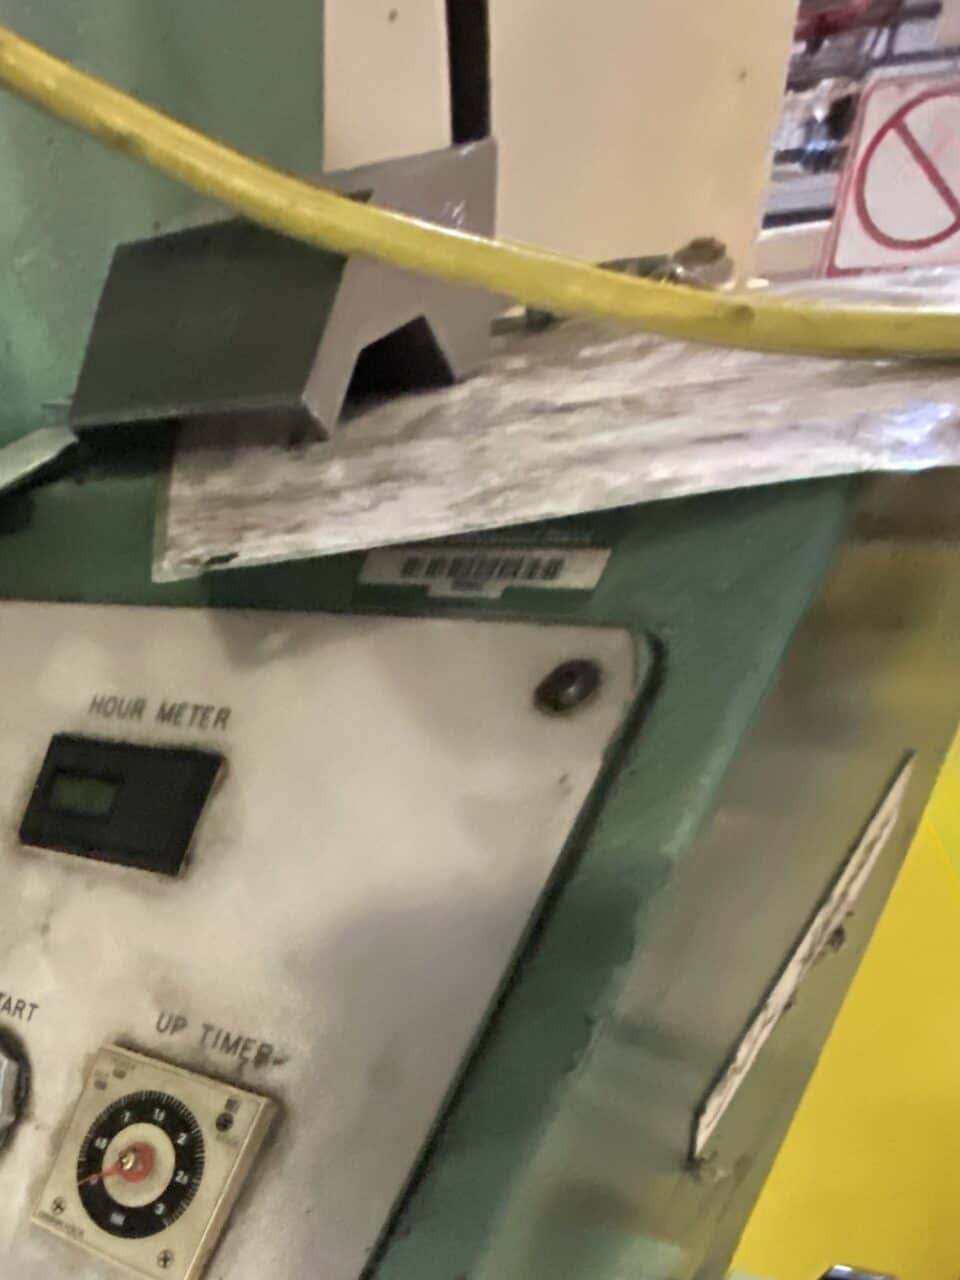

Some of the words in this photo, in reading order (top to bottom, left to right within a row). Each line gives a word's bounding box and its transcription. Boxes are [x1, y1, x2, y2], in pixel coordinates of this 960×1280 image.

[88, 694, 147, 721] HOUR
[154, 699, 232, 732] METER
[155, 1010, 188, 1036] UP
[200, 1022, 274, 1070] TIMER
[176, 1132, 188, 1145] 2
[154, 1203, 166, 1215] 3
